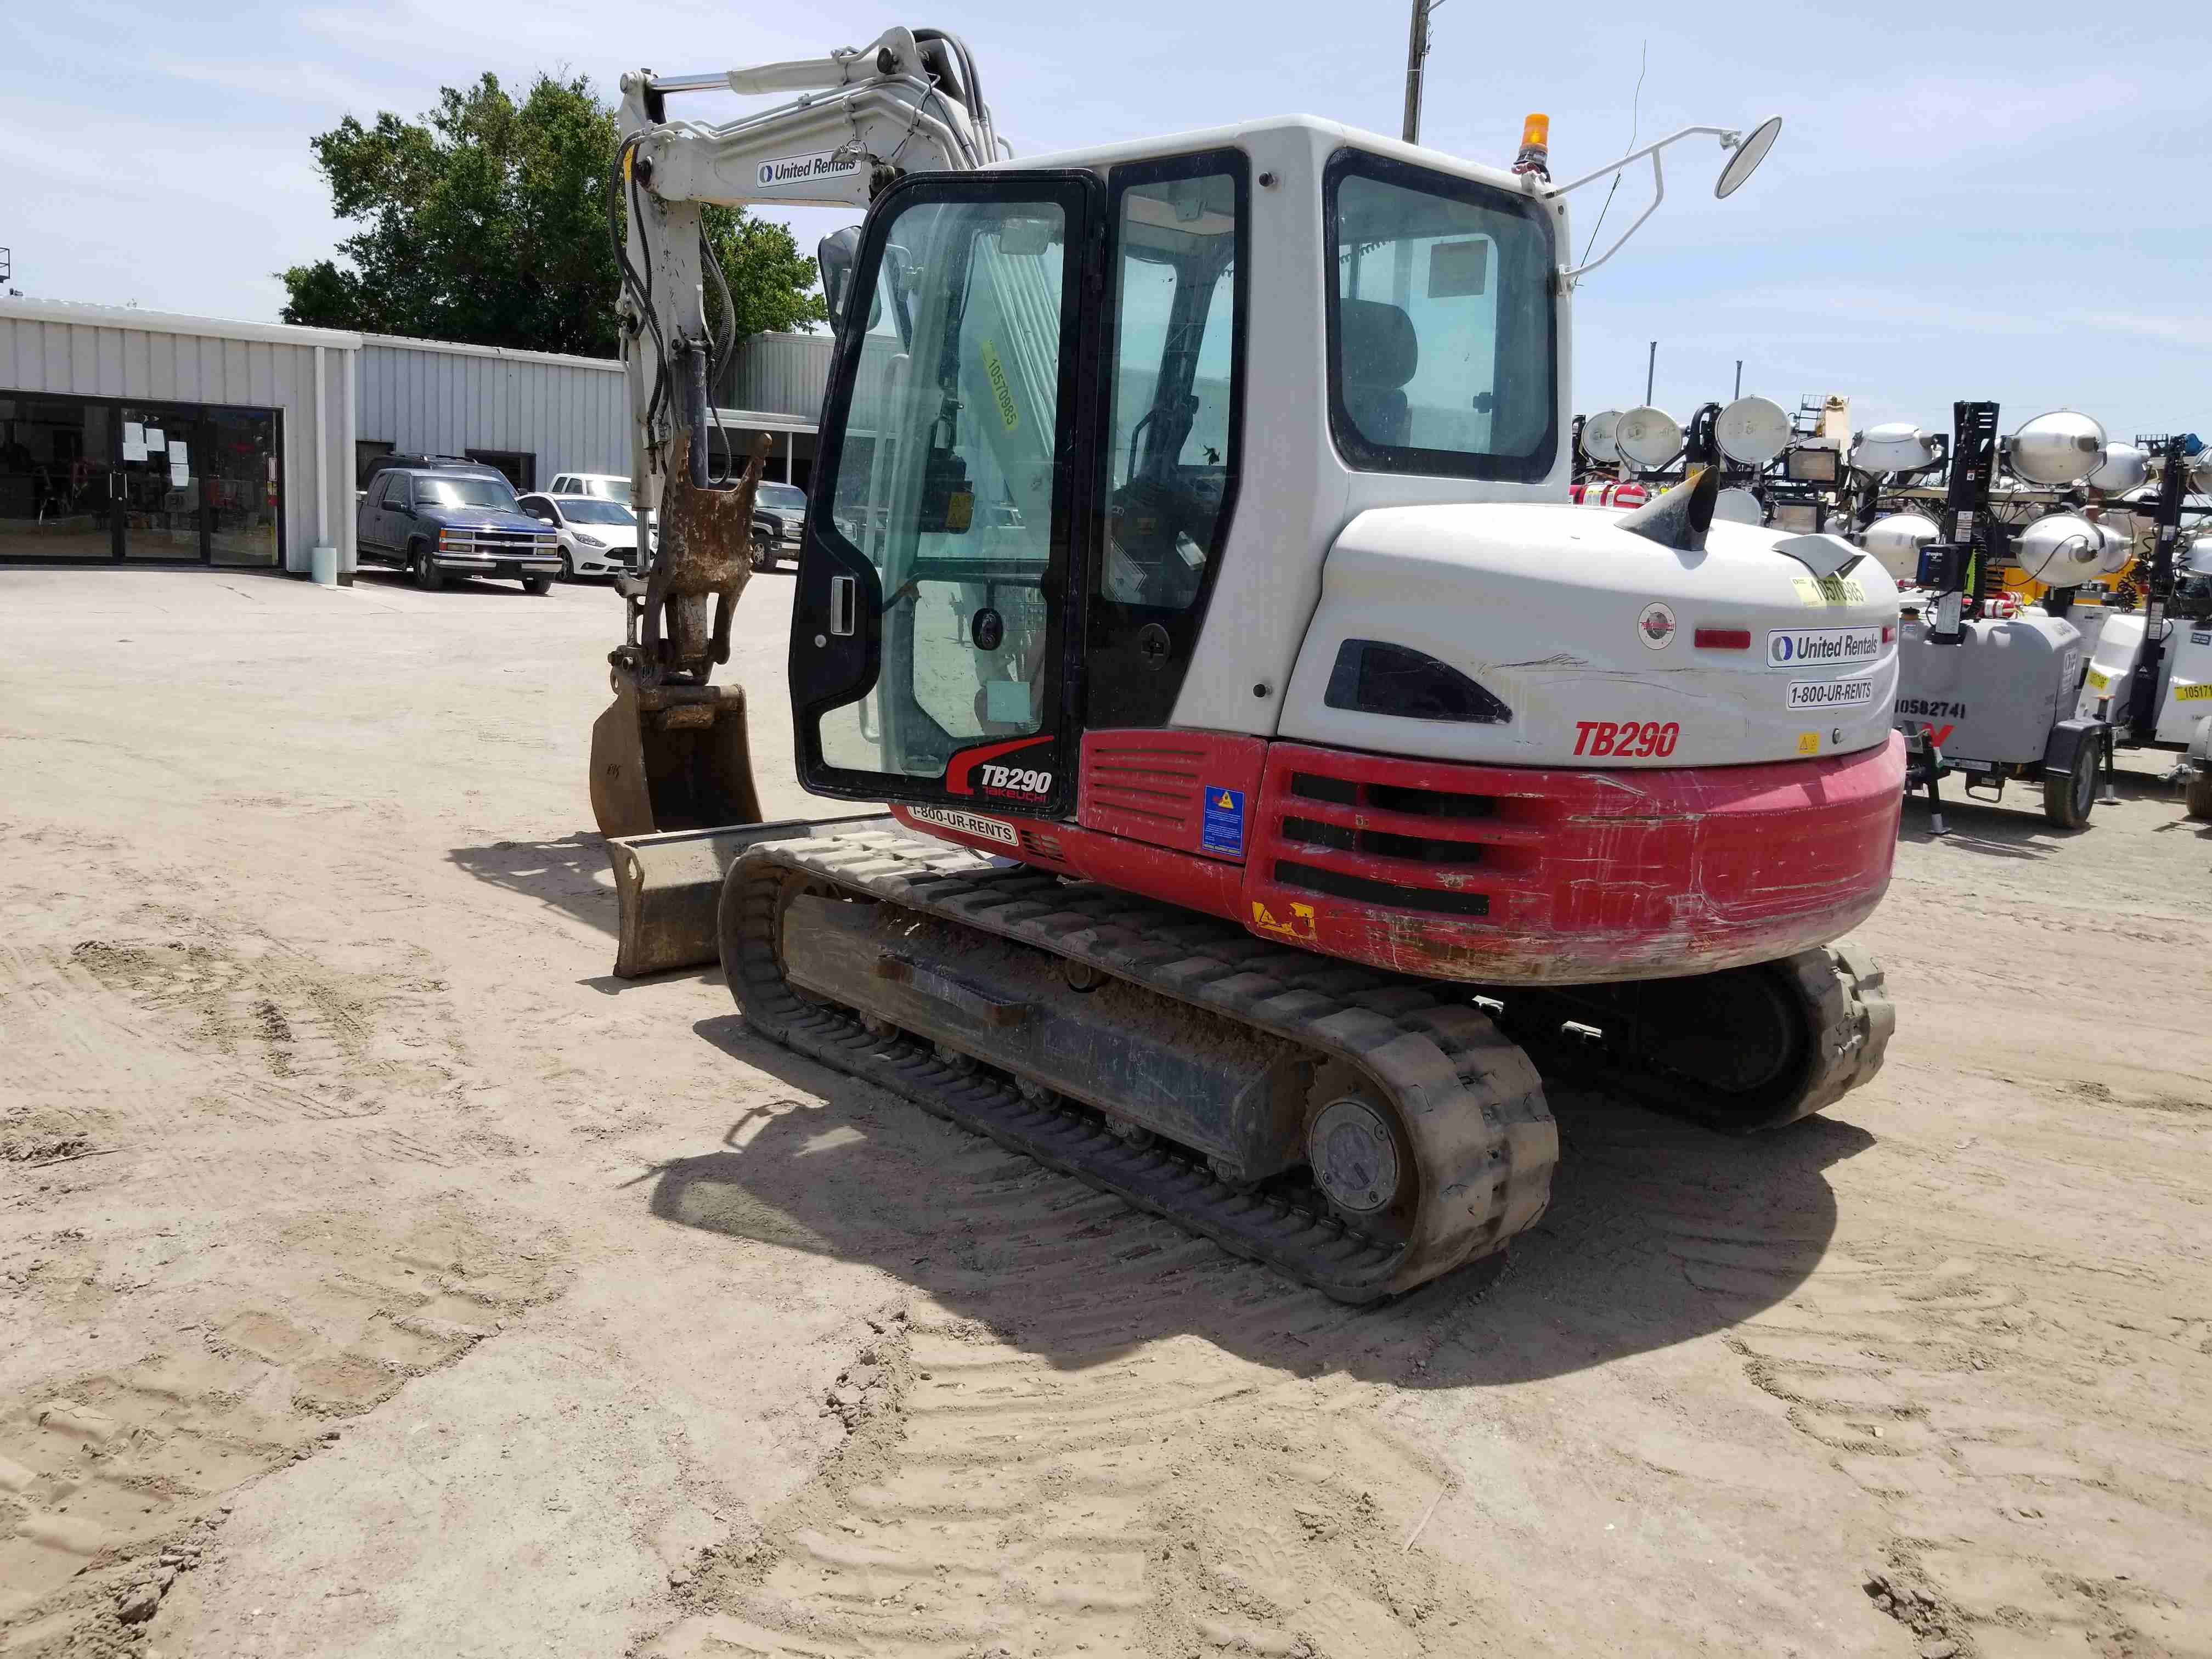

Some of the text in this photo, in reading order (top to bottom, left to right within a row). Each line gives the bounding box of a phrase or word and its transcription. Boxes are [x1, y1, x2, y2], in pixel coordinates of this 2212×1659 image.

[775, 160, 811, 180] United
[989, 358, 1017, 425] 10570985
[1811, 579, 1864, 602] 10570985
[1797, 633, 1877, 659] United Rentals
[1791, 682, 1872, 703] 1-800-UR-RENTS
[1894, 698, 1966, 719] 10582741
[1572, 721, 1680, 758] TB290
[981, 764, 1052, 793] TB290
[913, 806, 1012, 840] 1-800-UR-RENTS
